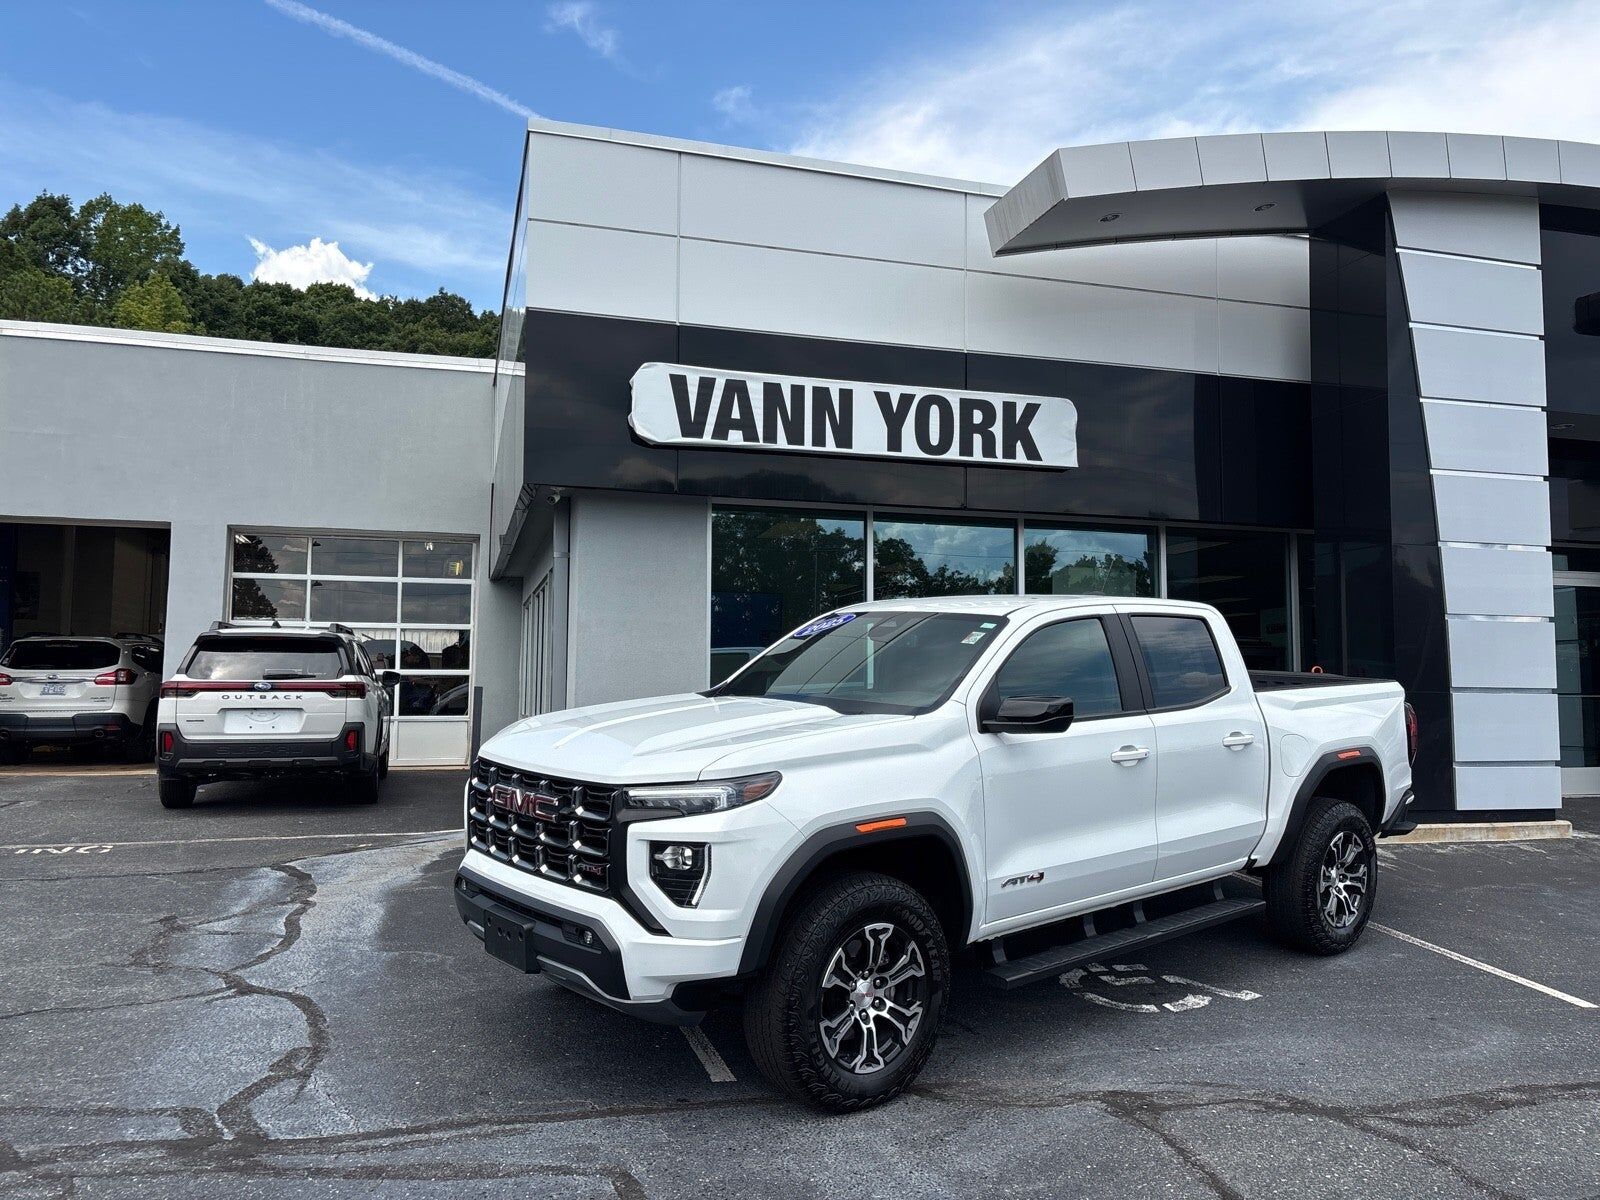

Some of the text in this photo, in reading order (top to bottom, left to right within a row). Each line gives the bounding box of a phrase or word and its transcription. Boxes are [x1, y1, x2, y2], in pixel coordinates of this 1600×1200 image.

[669, 373, 1043, 462] VANN YORK
[491, 784, 559, 822] GMC
[1001, 871, 1045, 889] AT4
